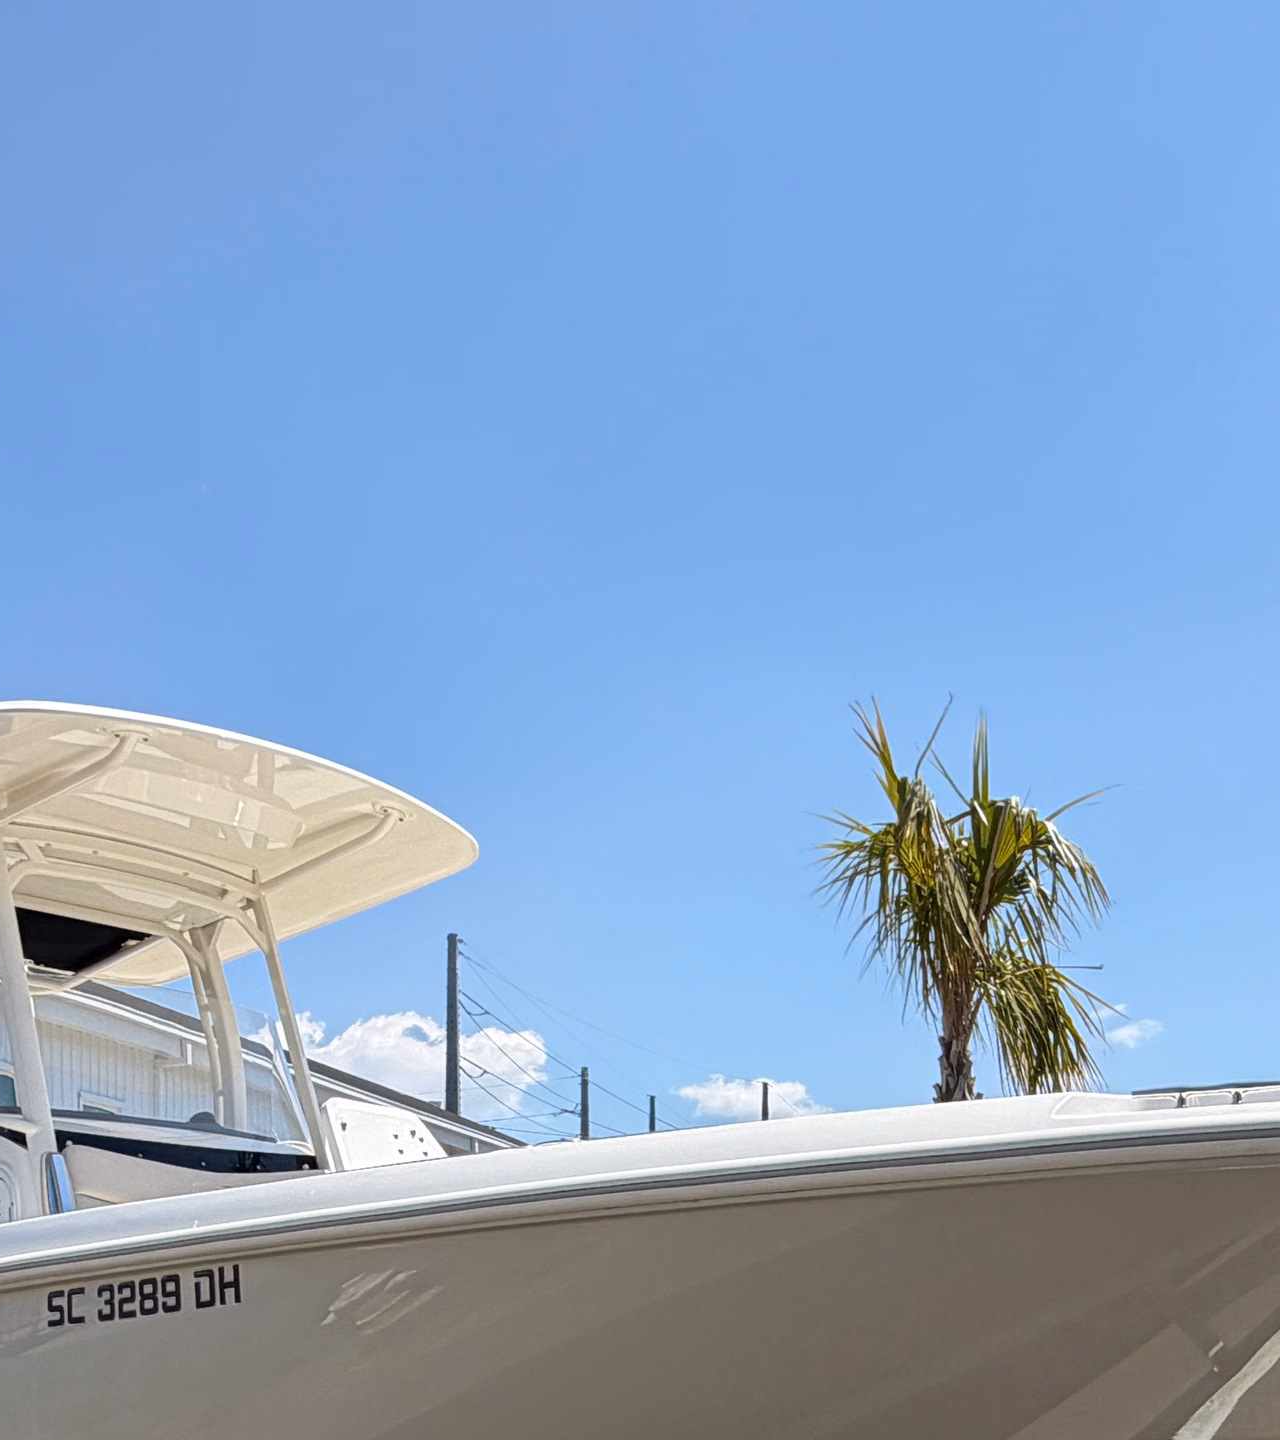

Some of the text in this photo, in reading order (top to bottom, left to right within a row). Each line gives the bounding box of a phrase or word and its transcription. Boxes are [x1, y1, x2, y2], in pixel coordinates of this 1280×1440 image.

[47, 1264, 241, 1327] SC 3289 DH
